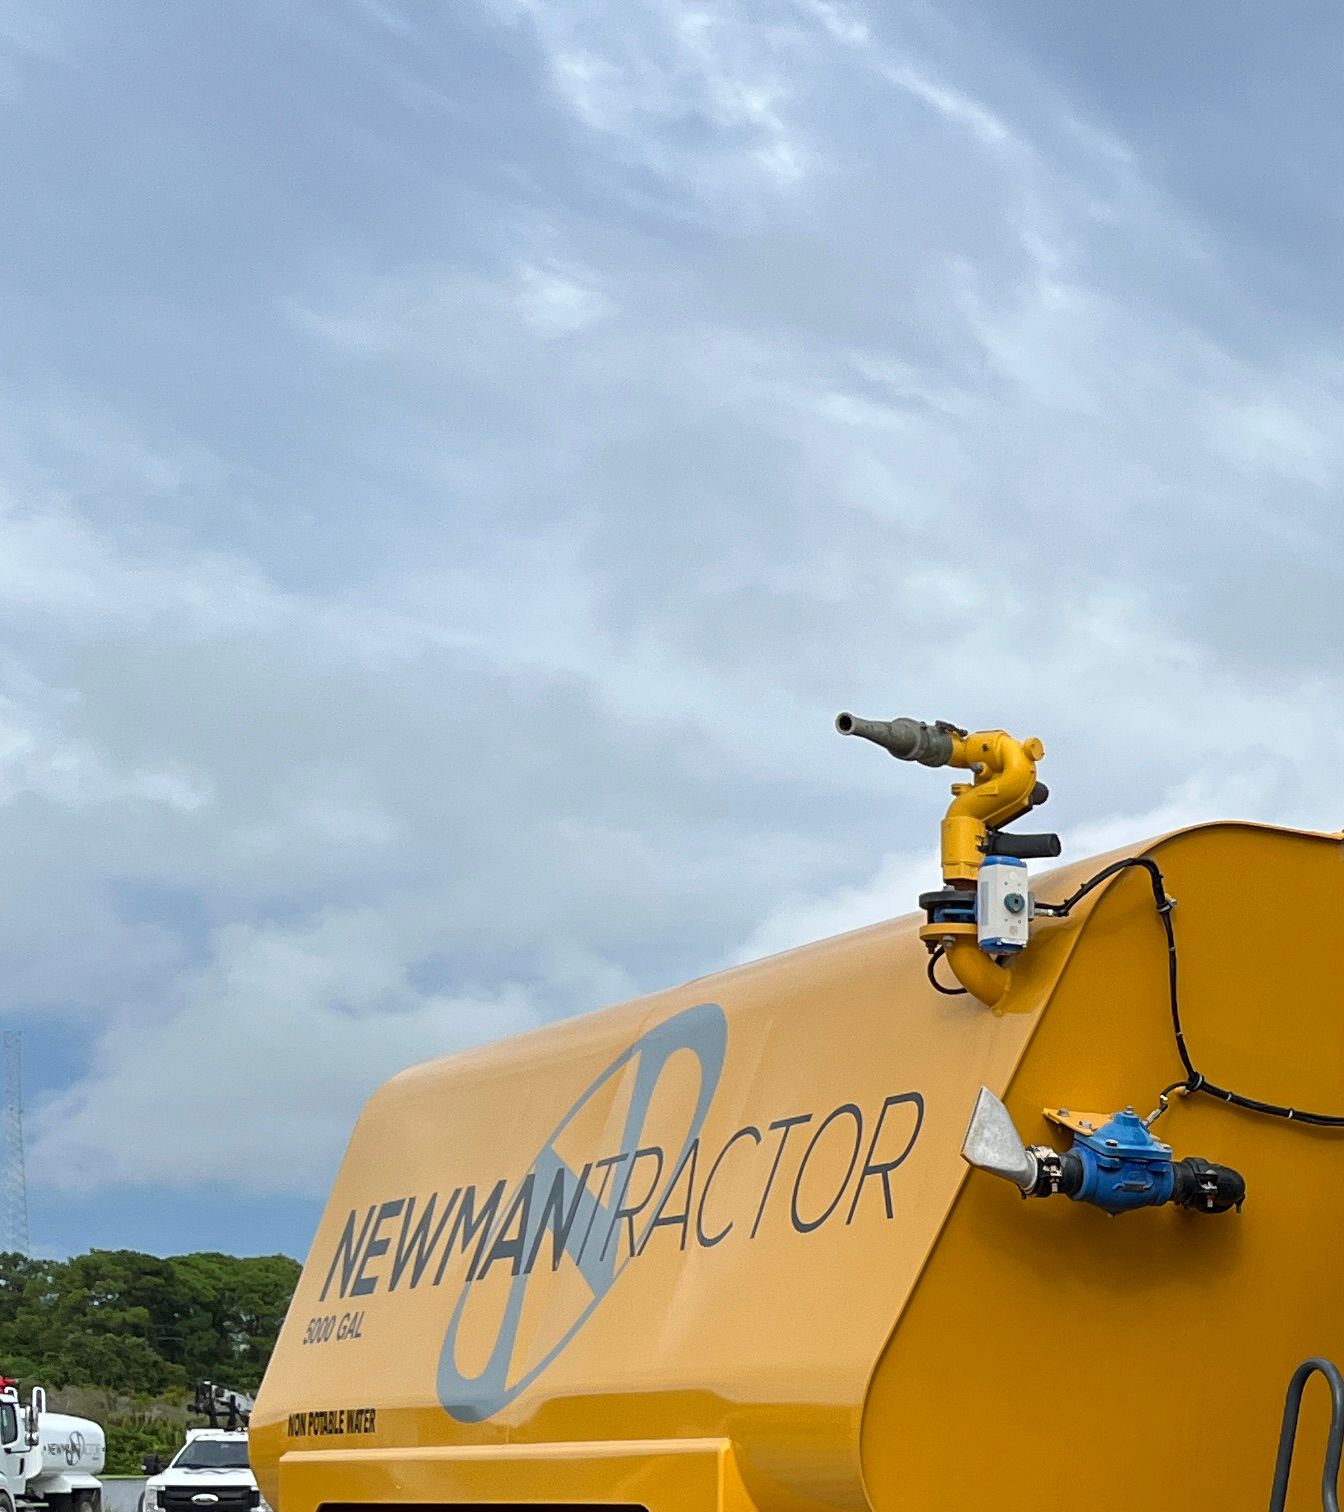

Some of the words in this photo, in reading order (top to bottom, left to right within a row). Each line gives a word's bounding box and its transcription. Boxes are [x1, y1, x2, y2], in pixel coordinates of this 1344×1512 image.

[302, 1314, 337, 1345] 5000
[336, 1310, 366, 1341] GAL
[287, 1412, 307, 1437] NON
[308, 1409, 345, 1436] POTABLE
[346, 1408, 376, 1434] WATER
